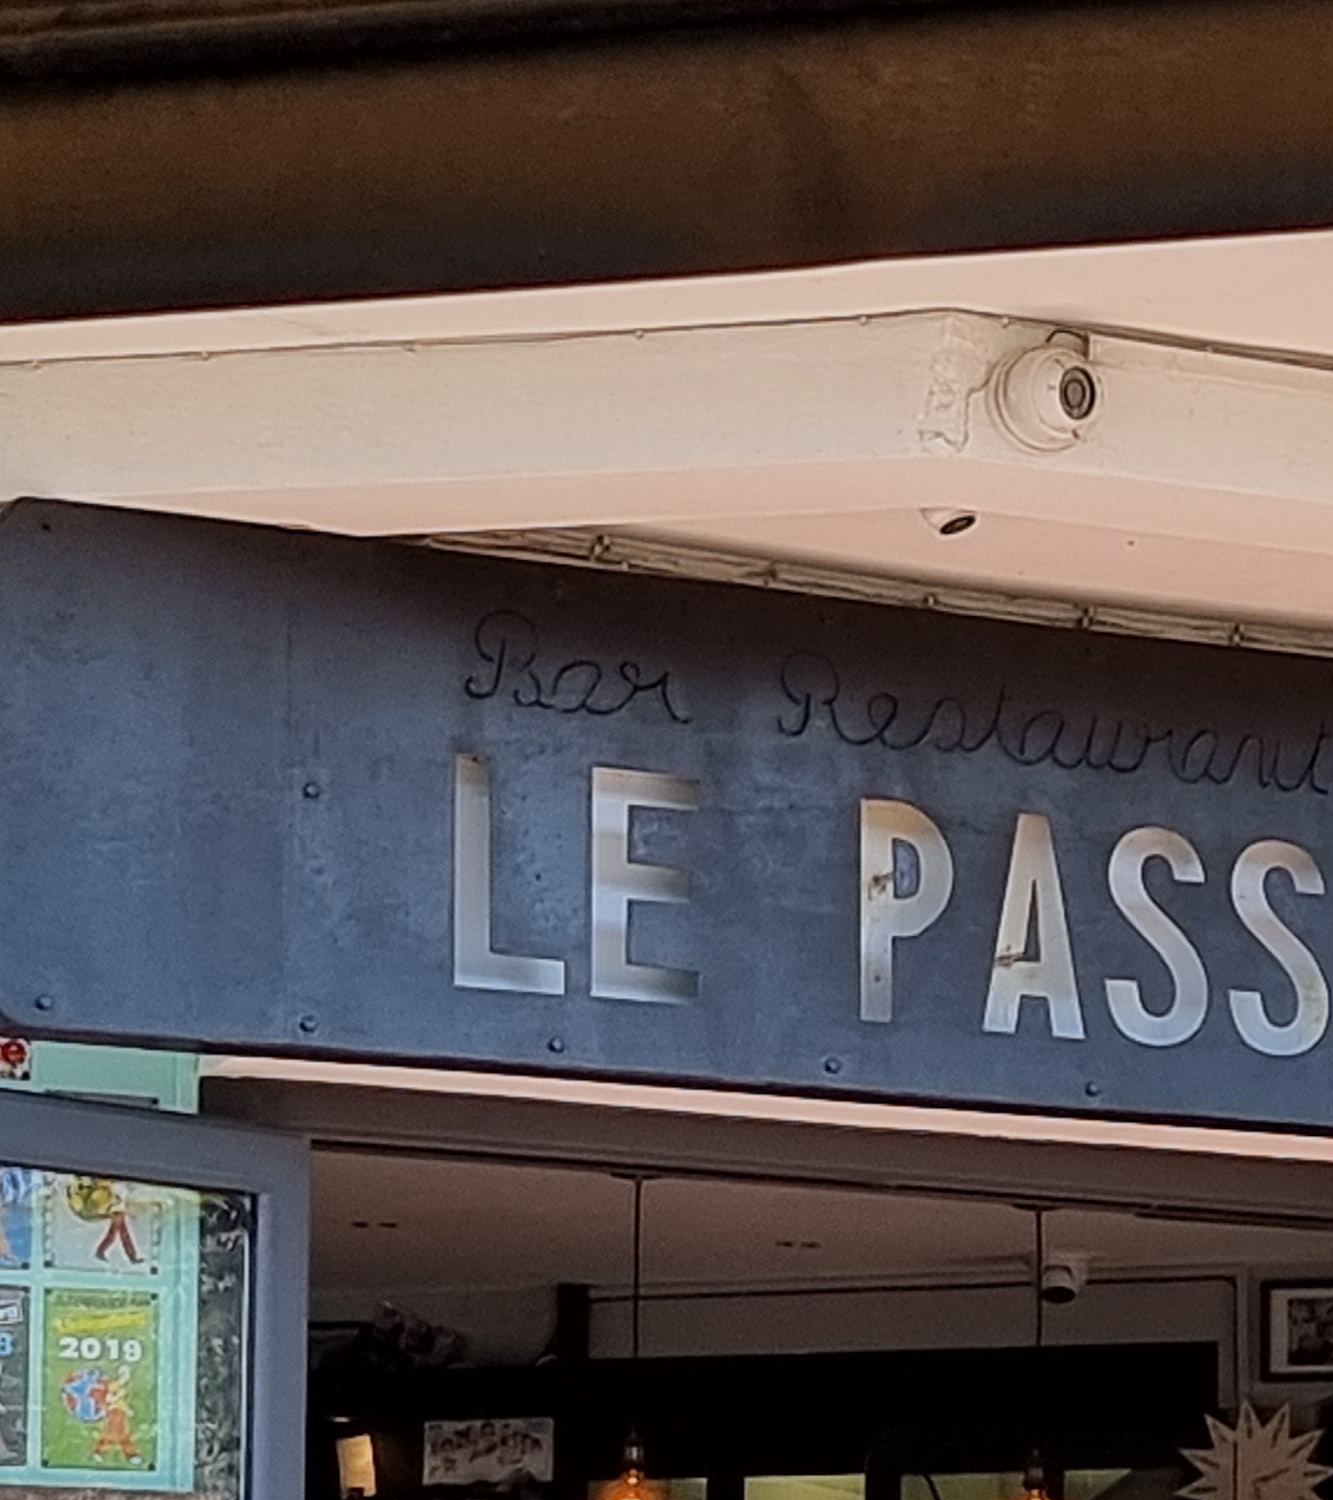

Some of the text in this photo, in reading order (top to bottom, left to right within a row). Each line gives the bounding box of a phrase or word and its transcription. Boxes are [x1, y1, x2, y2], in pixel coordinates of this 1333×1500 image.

[464, 609, 693, 725] Bar
[777, 651, 1329, 796] Restaurant
[453, 752, 700, 1005] LE
[59, 1336, 143, 1362] 2019
